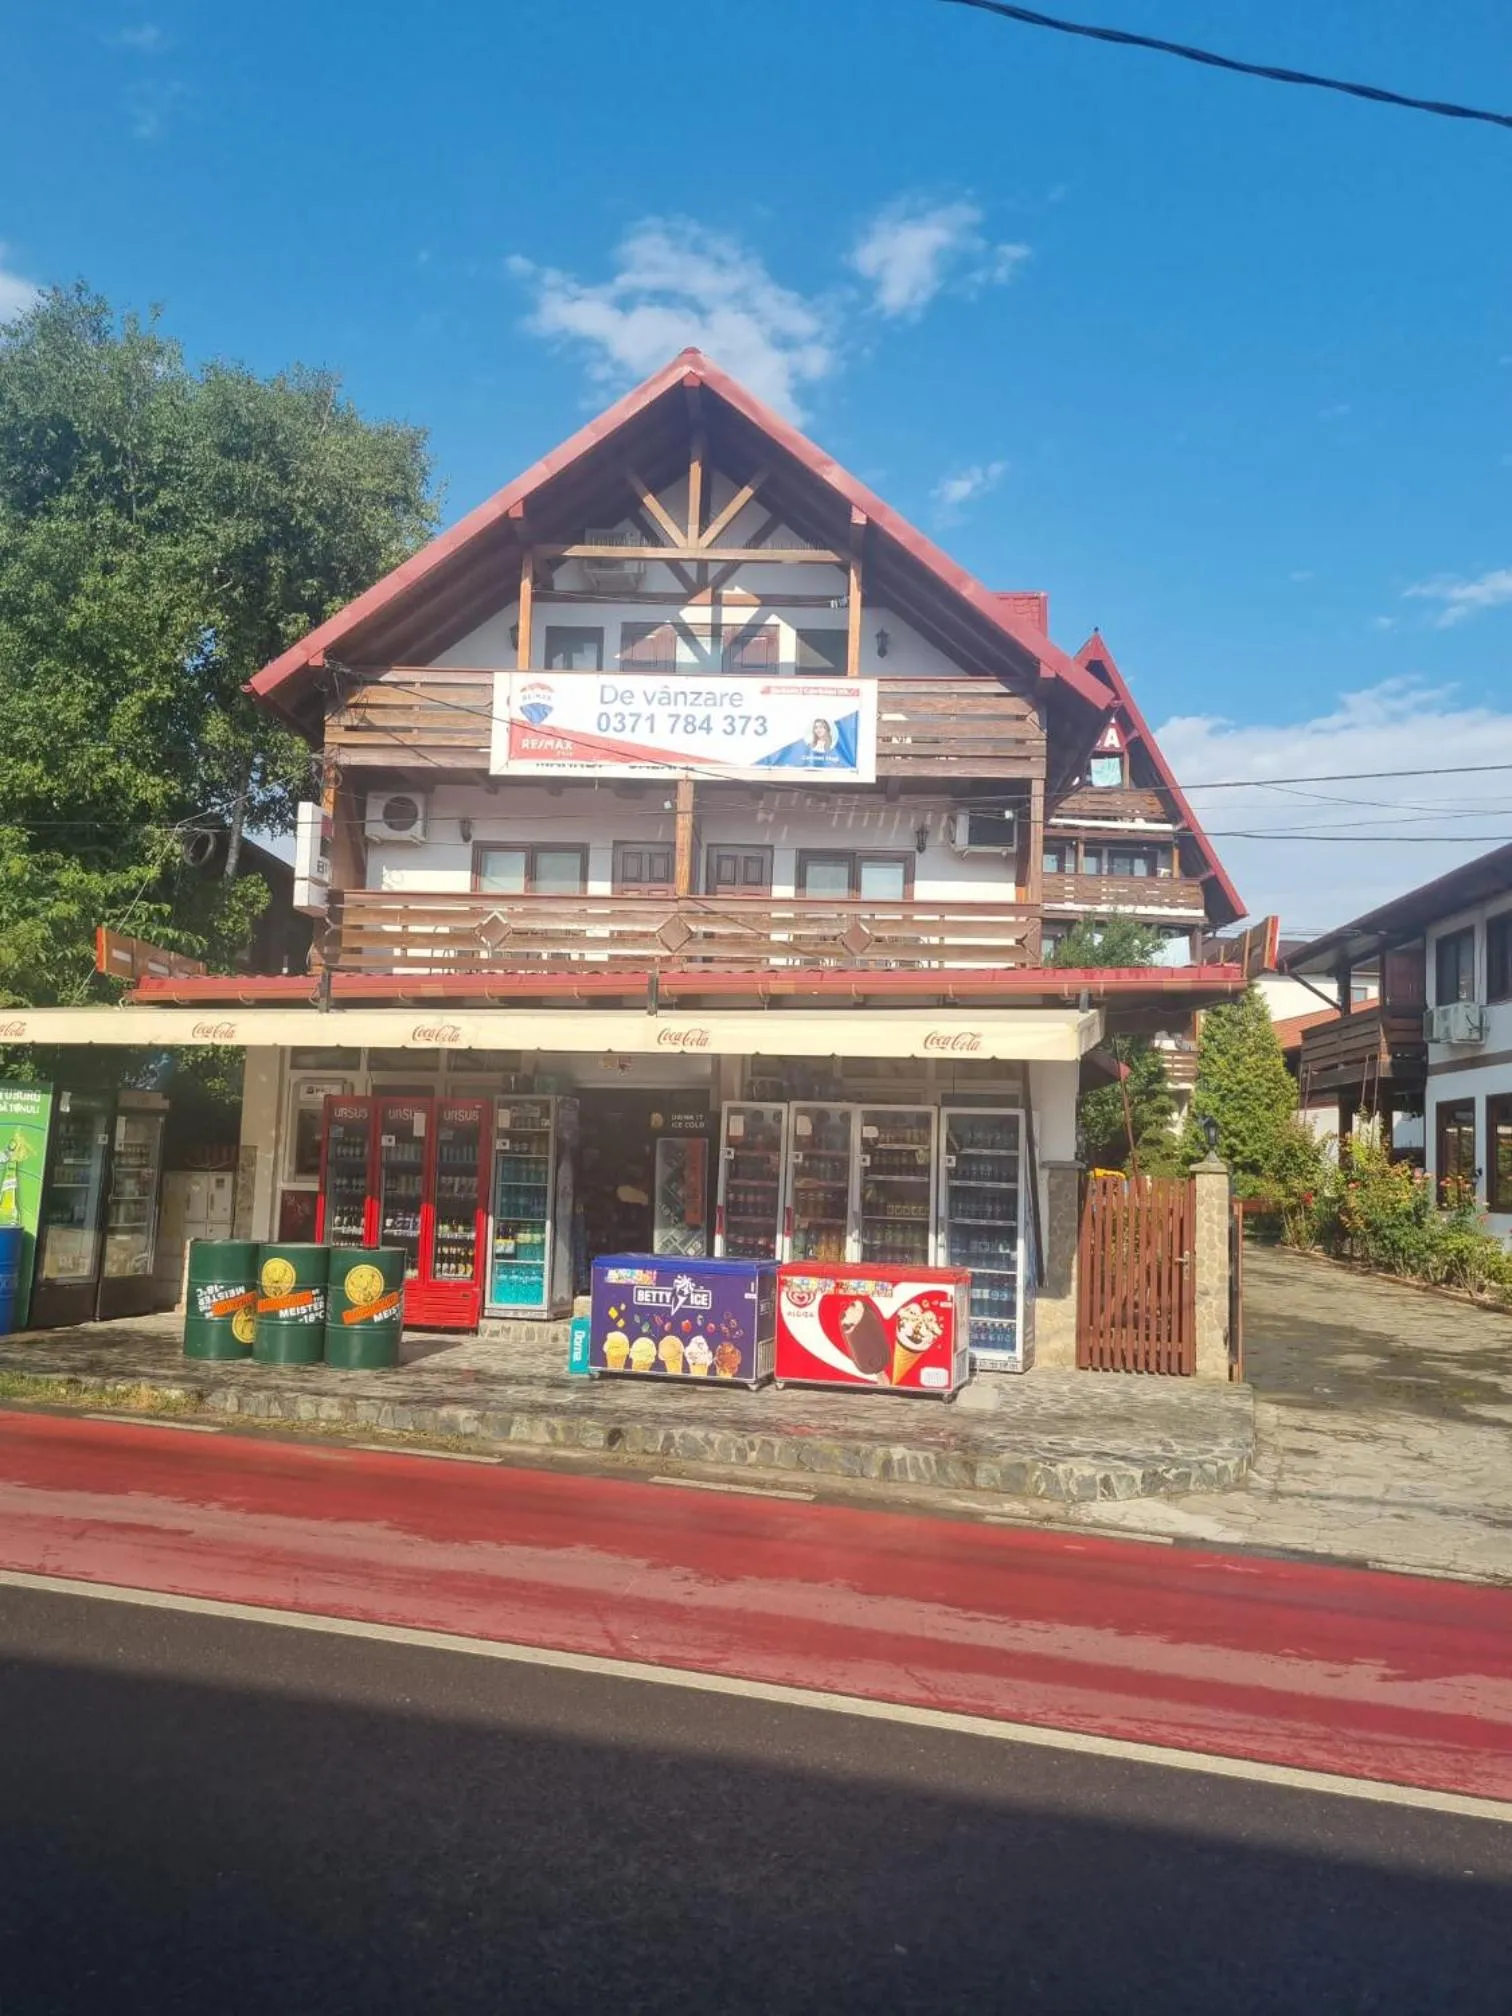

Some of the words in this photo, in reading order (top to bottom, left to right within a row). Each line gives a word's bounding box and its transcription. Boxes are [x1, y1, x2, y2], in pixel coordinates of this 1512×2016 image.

[600, 684, 635, 705] De
[642, 685, 744, 708] vânzare
[597, 711, 656, 734] 0371
[667, 712, 714, 736] 784
[721, 714, 769, 737] 373
[636, 1289, 671, 1304] BETTY
[689, 1293, 709, 1307] ICE
[278, 1301, 325, 1319] MEISTER
